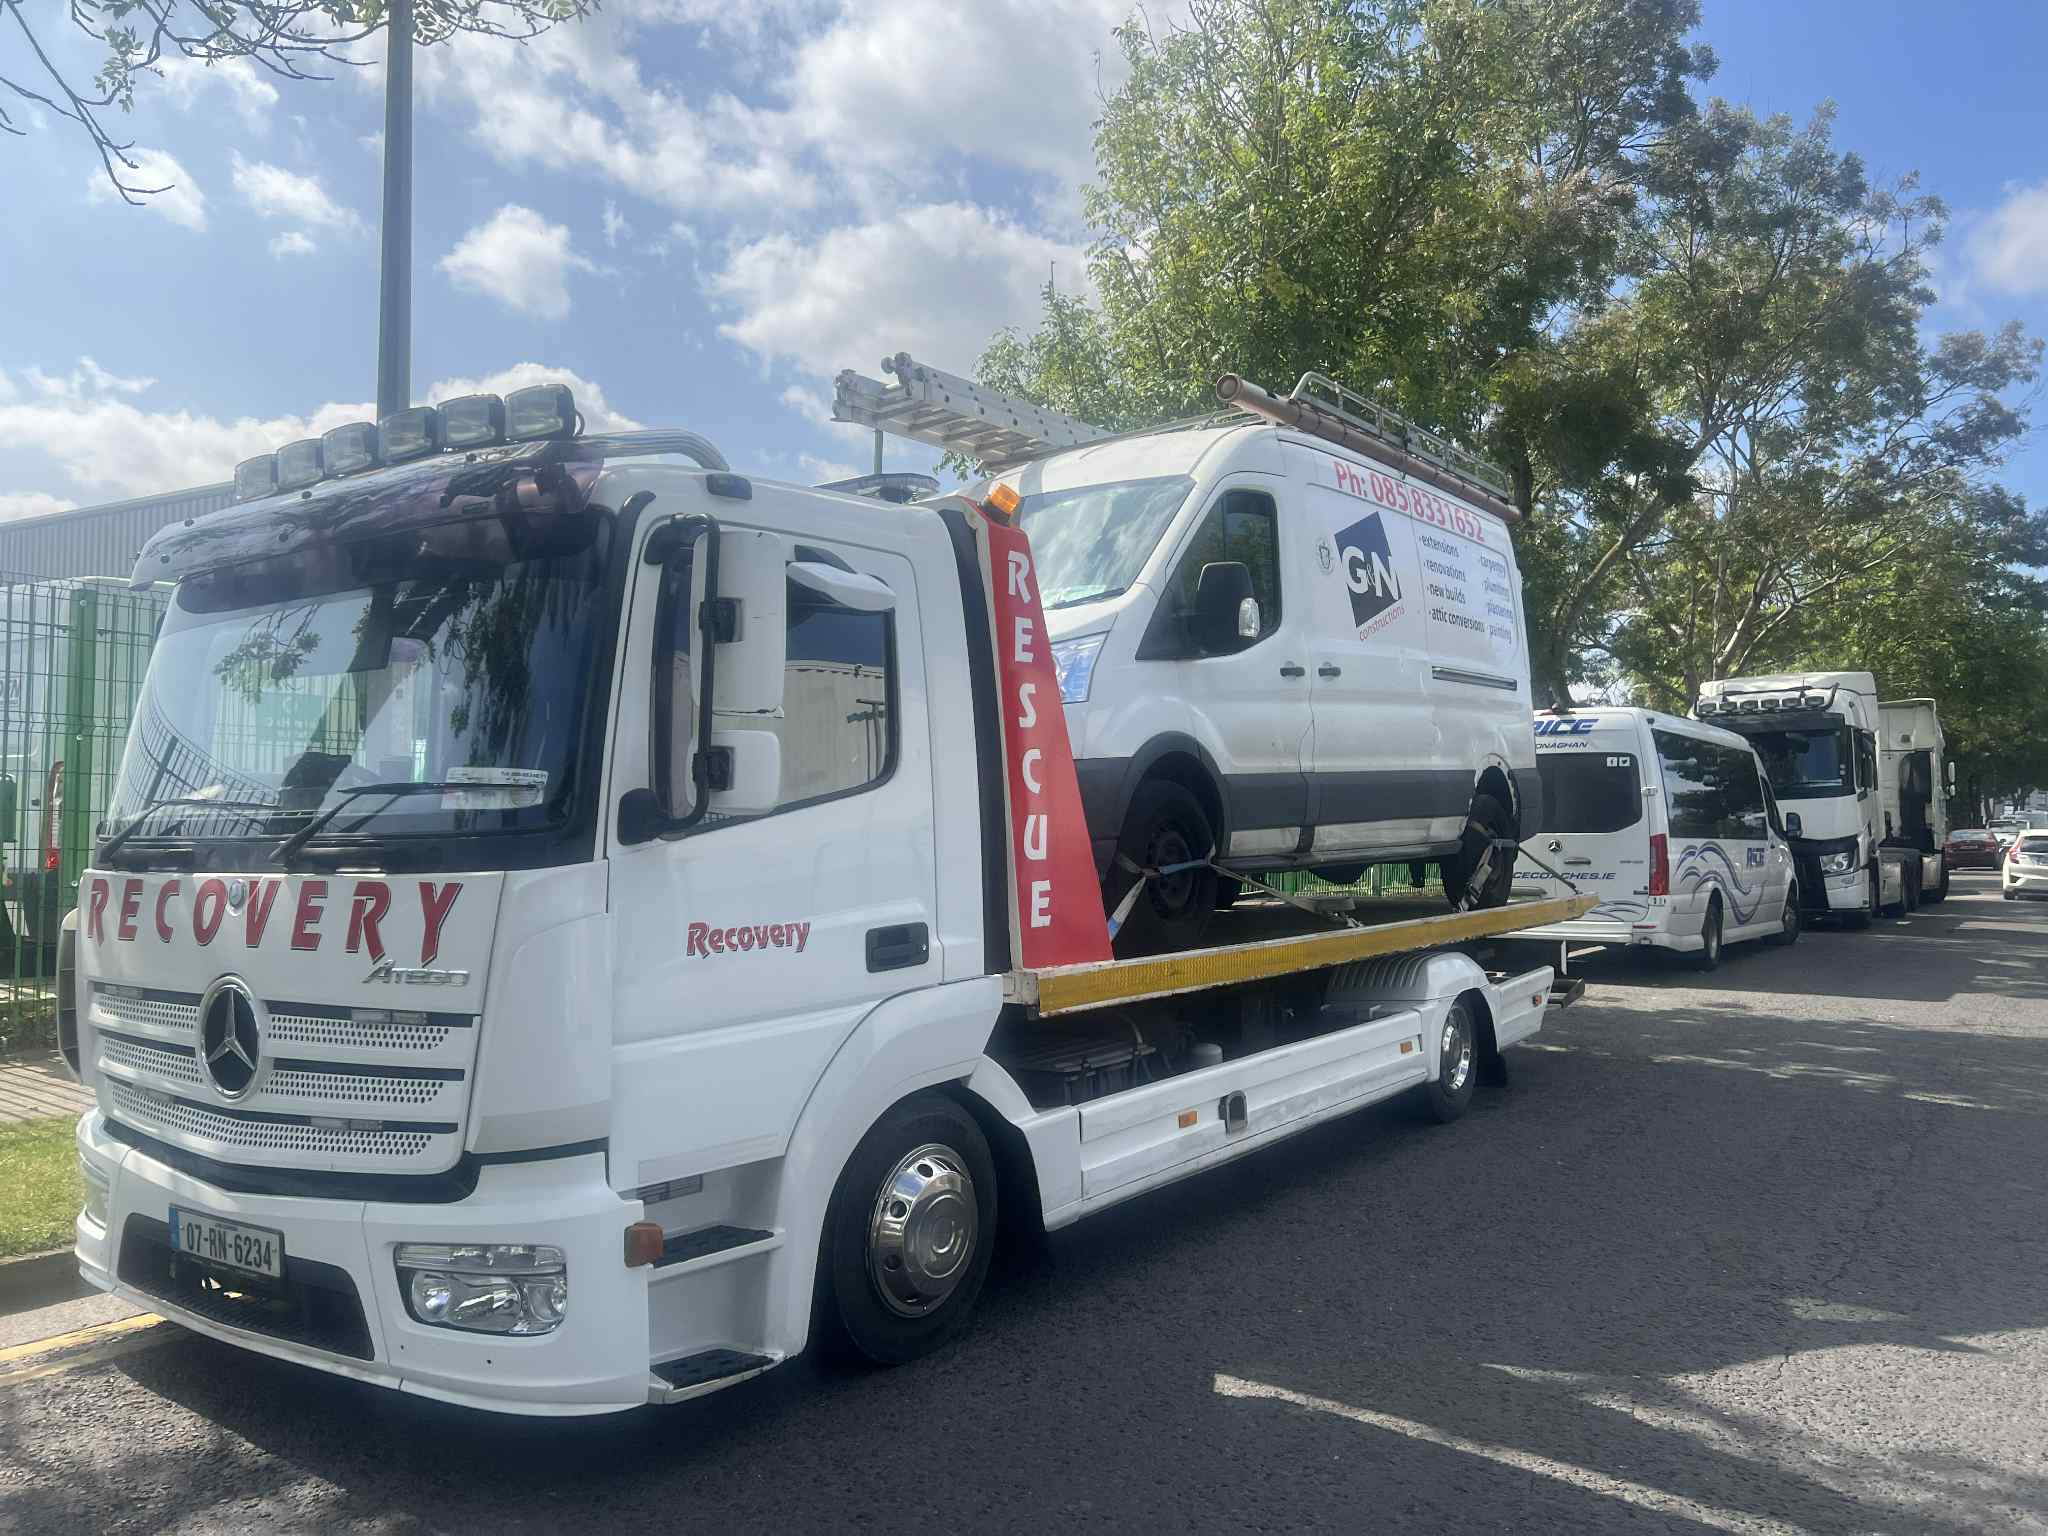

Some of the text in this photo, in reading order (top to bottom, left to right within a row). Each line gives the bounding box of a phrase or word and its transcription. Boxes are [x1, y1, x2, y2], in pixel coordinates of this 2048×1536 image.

[1333, 461, 1368, 498] Ph:
[1370, 471, 1409, 512] 085
[1422, 535, 1460, 558] extensions
[1425, 560, 1467, 583] renovations
[1429, 584, 1467, 605] new builds
[1359, 606, 1405, 641] constructions
[1432, 608, 1486, 633] attic conversions
[1008, 550, 1052, 928] RESCUE
[1536, 742, 1589, 750] ONAGHAN
[1513, 871, 1616, 880] CECOCHES.IE
[86, 878, 462, 968] RECOVERY
[686, 921, 811, 960] Recovery
[186, 1221, 273, 1272] 07-RN-6234
